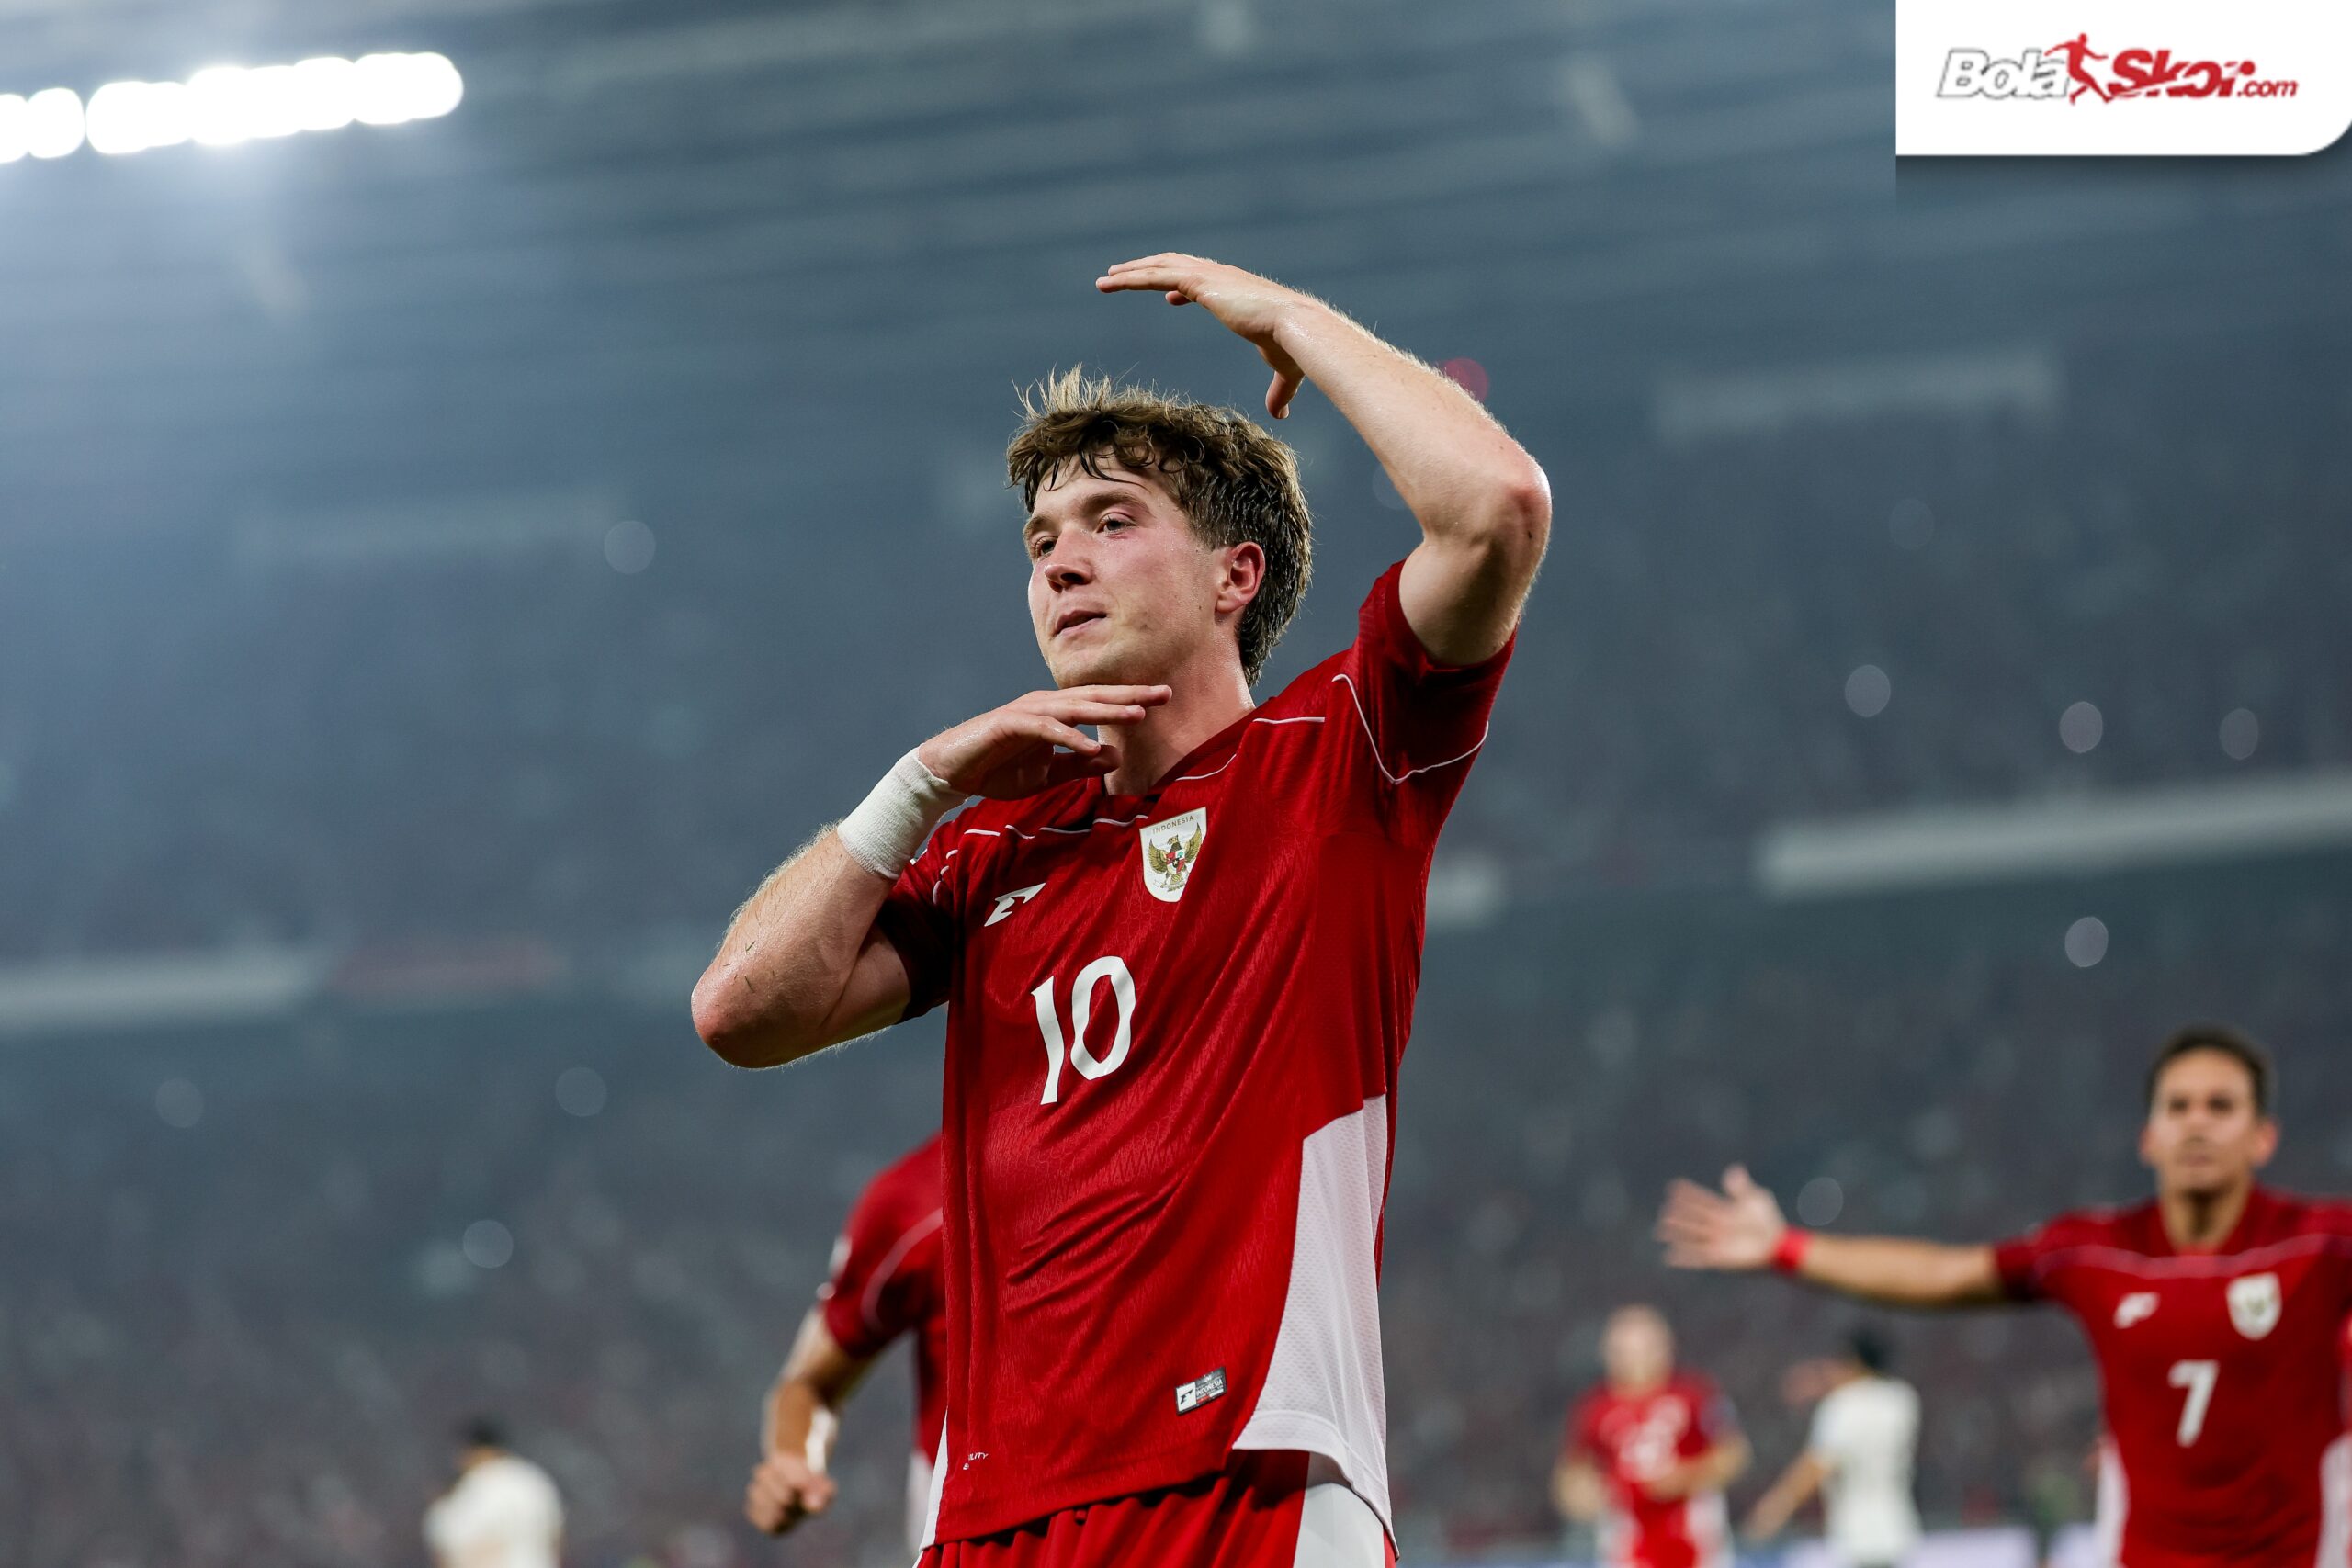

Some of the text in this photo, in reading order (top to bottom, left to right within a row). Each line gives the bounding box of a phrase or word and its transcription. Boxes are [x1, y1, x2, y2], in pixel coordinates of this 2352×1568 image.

[1152, 815, 1194, 834] INDONESIA
[1030, 955, 1136, 1105] 10
[2167, 1359, 2220, 1448] 7
